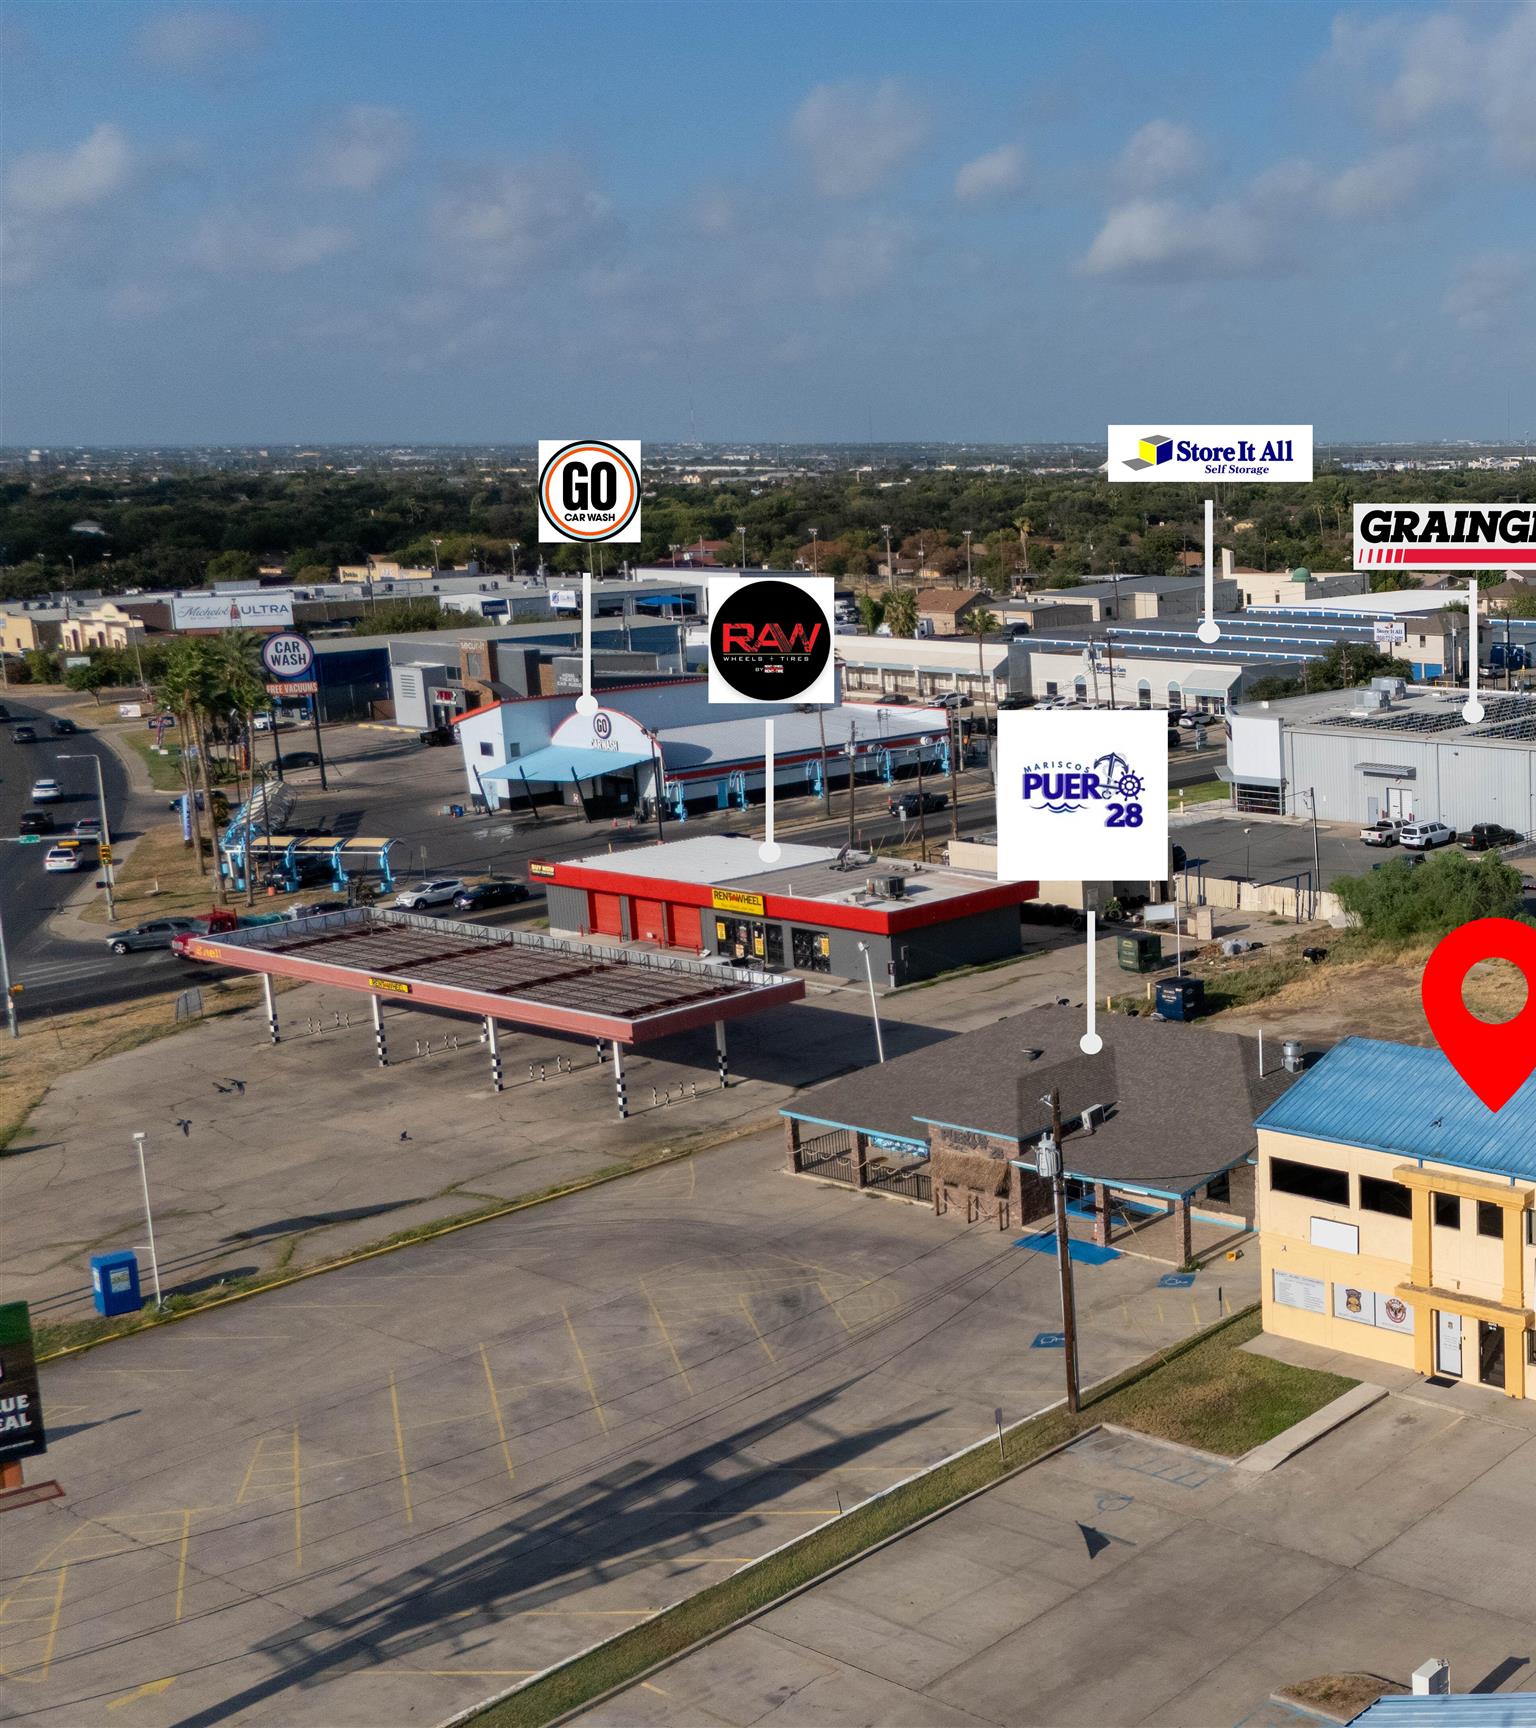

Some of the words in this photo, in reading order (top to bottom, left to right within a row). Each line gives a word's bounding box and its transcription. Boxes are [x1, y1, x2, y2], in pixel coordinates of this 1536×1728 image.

[241, 604, 289, 615] ULTRA
[274, 641, 301, 654] CAR
[271, 653, 307, 667] WASH
[266, 683, 285, 694] FREE
[285, 682, 318, 694] VACUUMS
[596, 718, 608, 733] GO
